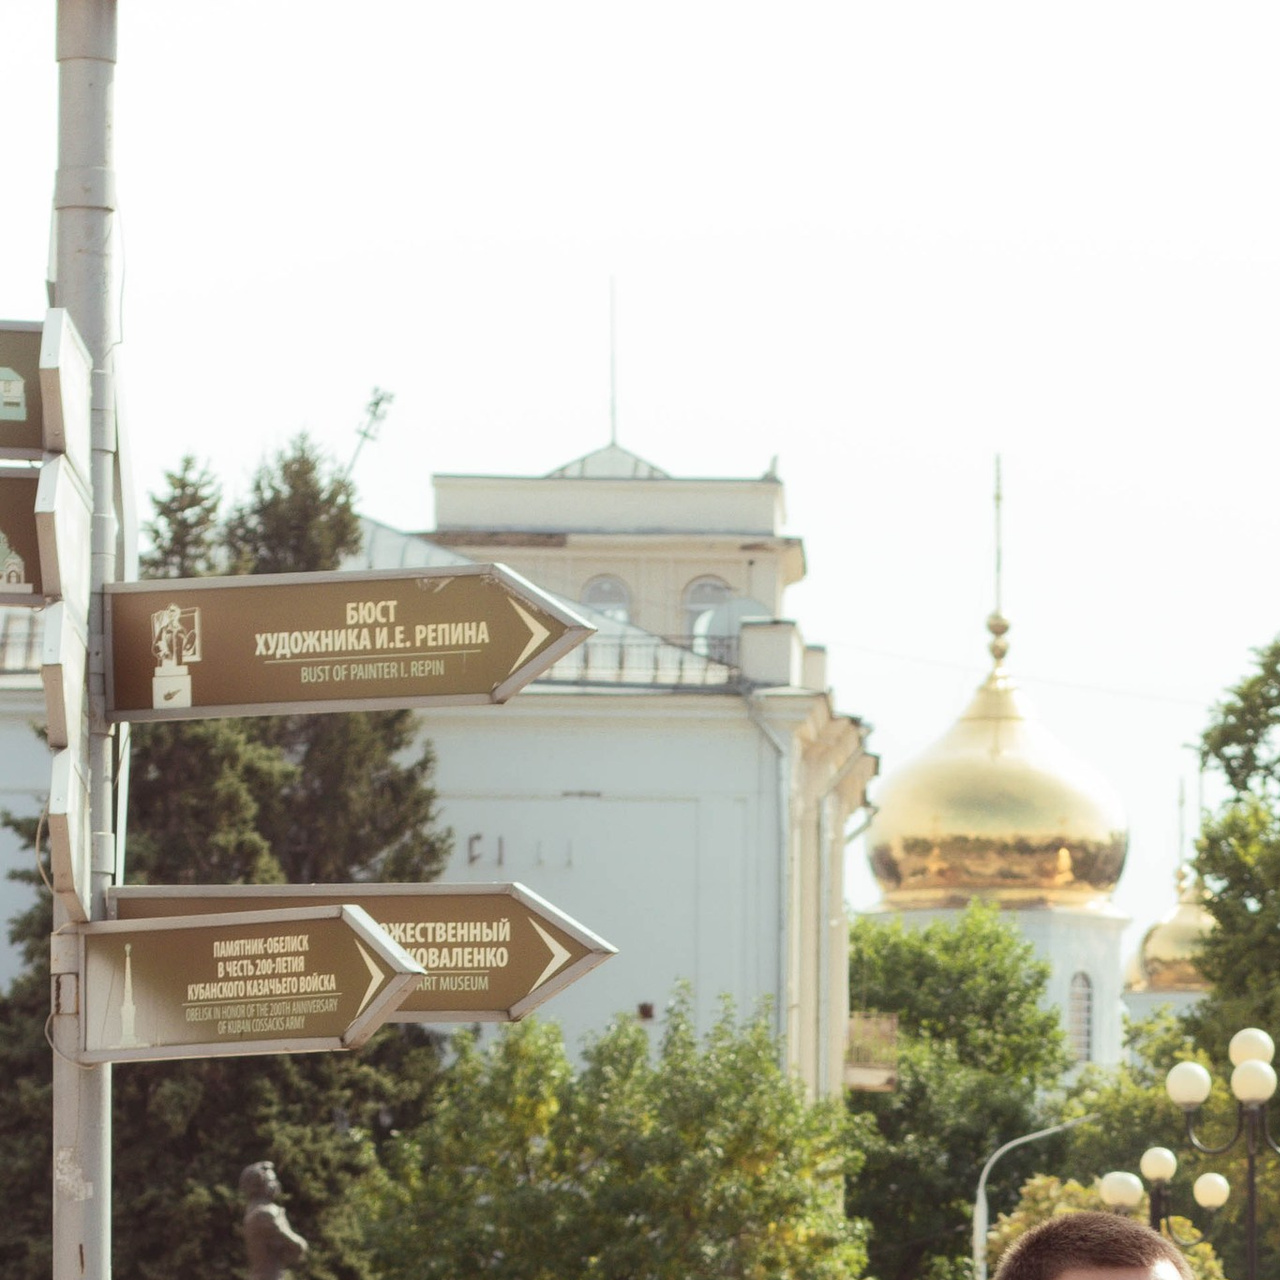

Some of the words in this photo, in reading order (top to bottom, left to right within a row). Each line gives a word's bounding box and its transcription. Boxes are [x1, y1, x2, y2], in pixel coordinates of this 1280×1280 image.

[346, 600, 398, 625] БЮСТ
[255, 628, 371, 658] ХУДОЖНИКА
[375, 625, 411, 649] И.Е.
[415, 621, 490, 647] РЕПИНА
[301, 665, 330, 683] BUST
[333, 664, 349, 681] OF
[351, 662, 397, 680] PAINTER
[401, 661, 409, 678] I.
[411, 660, 445, 677] REPIN
[213, 935, 309, 958] ПАМЯТНИК-ОБЕЛИСК
[217, 962, 225, 978] В
[226, 959, 254, 977] ЧЕСТЬ
[255, 956, 305, 976] 200-ЛЕТИЯ
[187, 980, 245, 1001] КУБАНСКОГО
[246, 977, 298, 997] КАЗАЧЬЕГО
[299, 972, 336, 992] ВОЙСКА
[416, 976, 439, 991] ART
[439, 976, 489, 991] MUSEUM
[185, 1006, 213, 1021] OBELISK
[213, 1006, 221, 1020] IN
[222, 1004, 246, 1019] HONOR
[247, 1003, 256, 1018] OF
[256, 1002, 269, 1017] THE
[270, 1001, 291, 1016] 200TH
[292, 998, 338, 1015] ANNIVERSARY
[217, 1020, 227, 1034] OF
[227, 1019, 251, 1033] KUBAN
[252, 1017, 284, 1031] COSSACKS
[285, 1015, 305, 1030] ARMY
